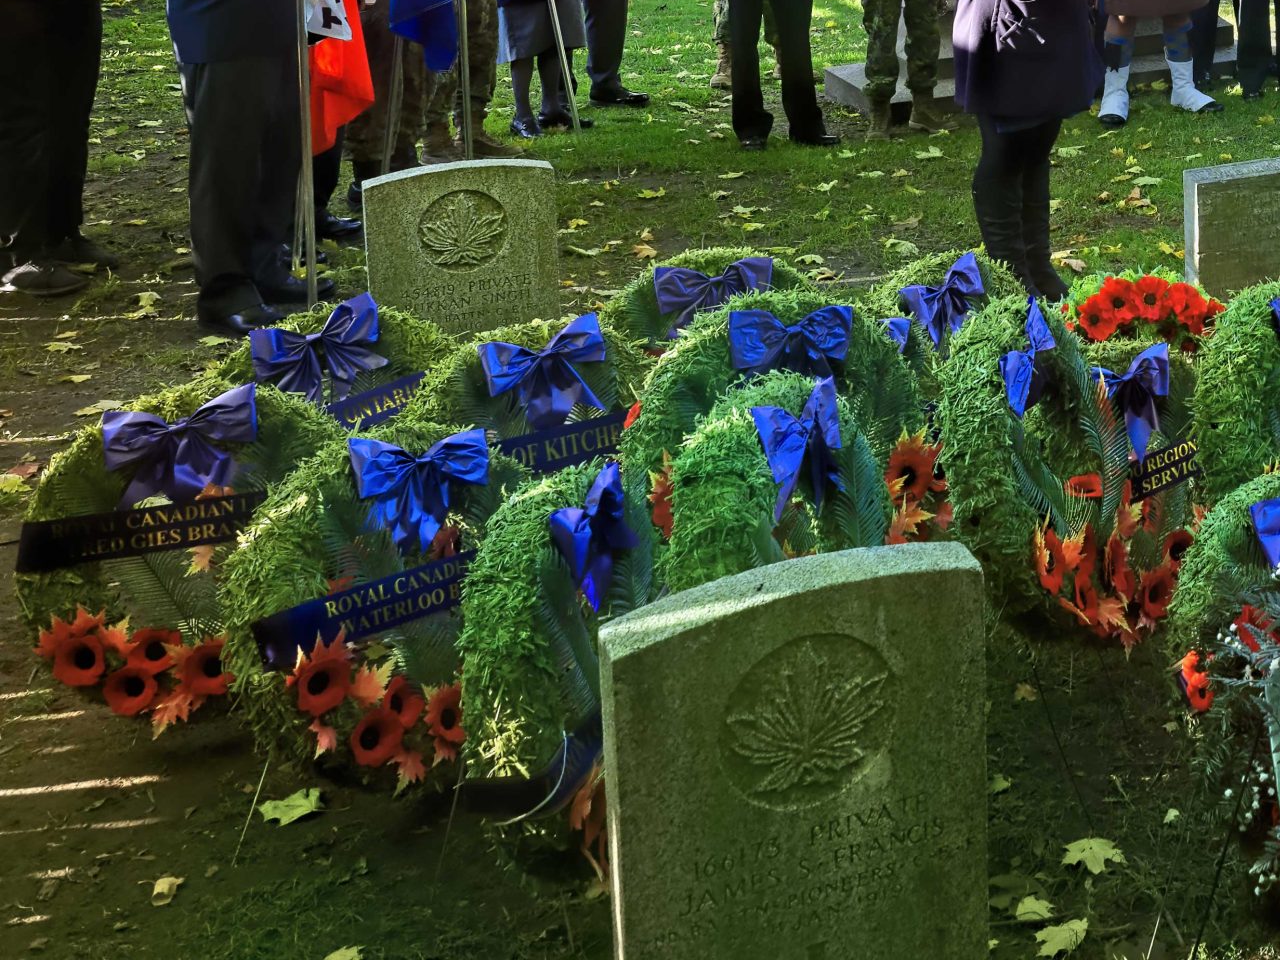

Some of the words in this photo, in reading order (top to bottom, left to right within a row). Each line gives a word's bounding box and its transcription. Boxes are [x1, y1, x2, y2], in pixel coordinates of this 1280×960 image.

[469, 273, 532, 292] PRIVATE
[482, 288, 531, 304] SINGH
[512, 443, 538, 466] OF
[544, 423, 621, 461] KITCHE
[1147, 438, 1198, 472] REGION
[1142, 459, 1197, 493] SERVIC
[126, 499, 235, 529] CANADIAN
[131, 527, 182, 549] GIES
[325, 584, 391, 618] ROYAL
[394, 561, 464, 595] CANADI
[339, 587, 446, 635] WATERLOO
[810, 793, 930, 846] PRIVATE
[679, 867, 782, 917] JAMES
[834, 816, 946, 868] FRANCIS
